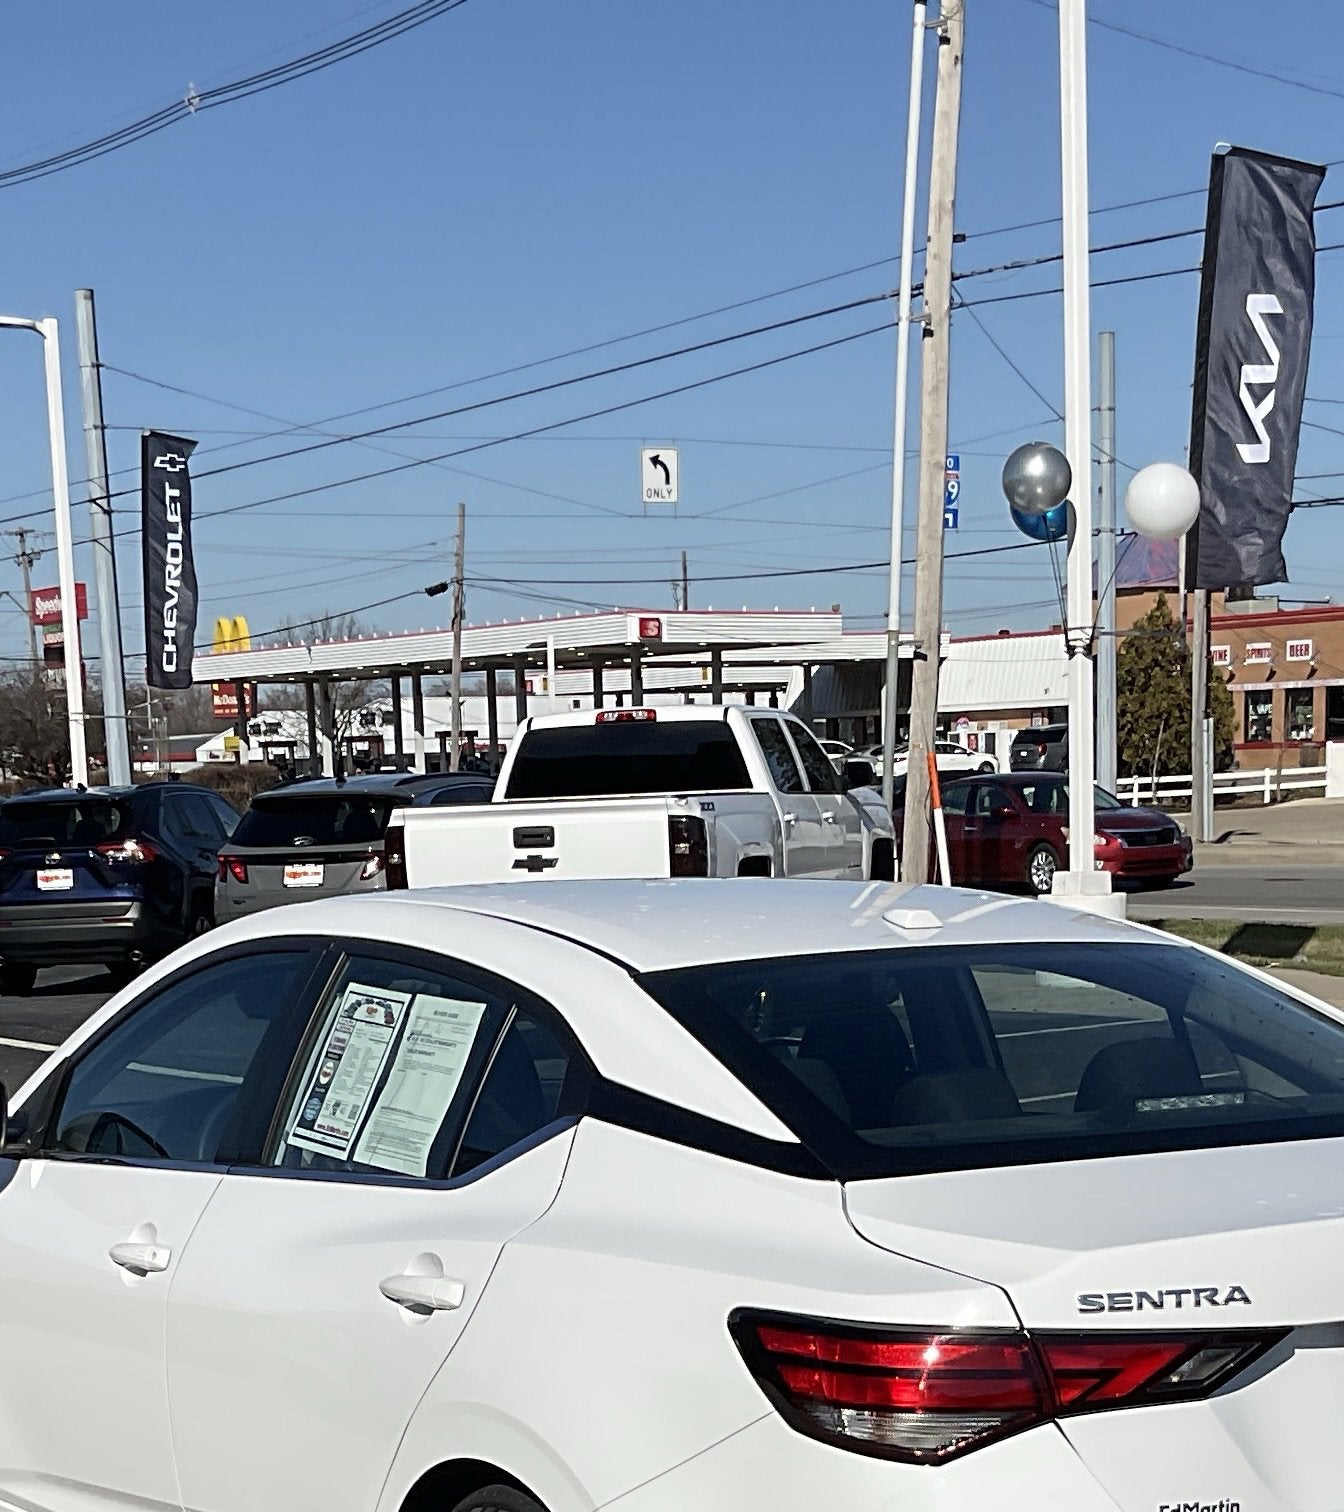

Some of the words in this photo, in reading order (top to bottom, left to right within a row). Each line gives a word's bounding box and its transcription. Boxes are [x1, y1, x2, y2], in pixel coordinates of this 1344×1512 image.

[646, 488, 673, 499] ONLY
[163, 482, 183, 673] CHEVROLET
[1289, 644, 1310, 657] BEER
[1078, 1285, 1252, 1314] SENTRA
